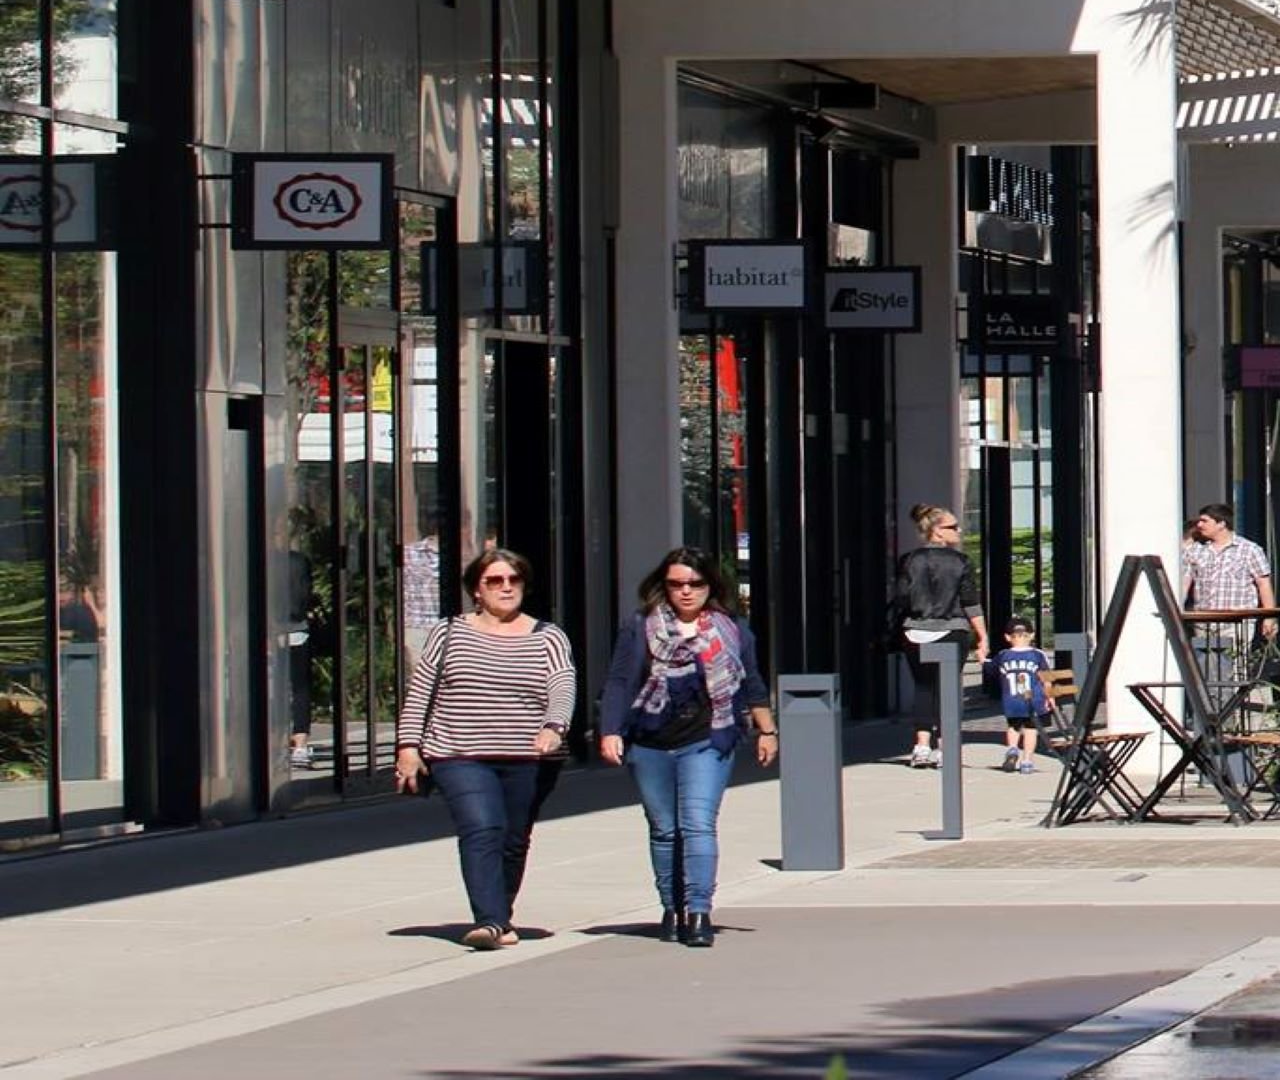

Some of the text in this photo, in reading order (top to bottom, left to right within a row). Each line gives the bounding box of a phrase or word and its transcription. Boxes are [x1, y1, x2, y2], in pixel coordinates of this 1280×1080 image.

[289, 188, 346, 213] C&A
[708, 267, 788, 287] habitat
[986, 312, 1013, 322] LA
[986, 325, 1058, 336] HALLE
